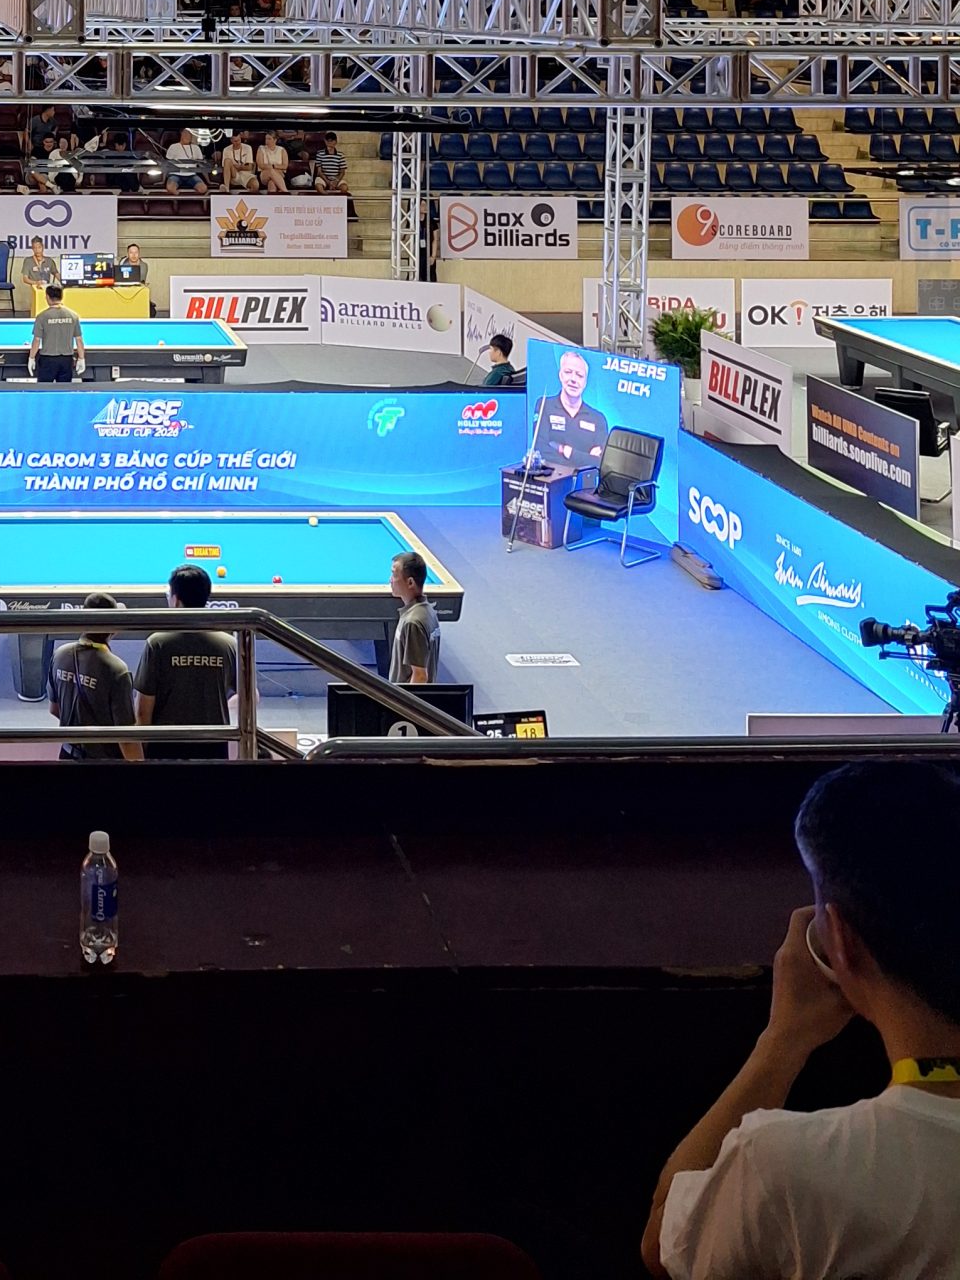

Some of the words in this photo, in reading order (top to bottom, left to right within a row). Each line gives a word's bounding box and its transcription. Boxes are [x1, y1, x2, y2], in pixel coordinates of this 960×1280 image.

[483, 208, 525, 227] box
[483, 228, 571, 247] billiards
[711, 224, 793, 237] SCOREBOARD
[7, 235, 92, 249] BILINITY
[222, 237, 263, 246] BILLIARDS
[94, 262, 107, 271] 21
[186, 296, 308, 324] BILLPLEX
[338, 302, 422, 322] aramith
[339, 318, 386, 328] BILLIARD
[391, 321, 422, 330] BALLS
[602, 357, 667, 381] JASPERS
[617, 379, 651, 398] DICK
[708, 359, 782, 424] BILLPLEX
[116, 400, 182, 426] HBSF
[97, 427, 130, 437] WORLD
[133, 427, 152, 437] CUP
[26, 453, 95, 468] CAROM
[99, 453, 111, 468] 3
[115, 449, 168, 468] BĂNG
[173, 450, 212, 469] CÚP
[216, 448, 254, 468] THẾ
[257, 450, 297, 468] GIỚI
[811, 422, 912, 489] billiards.sooplive.com
[24, 472, 88, 490] THÀNH
[93, 471, 136, 490] PHỐ
[137, 472, 168, 490] HỒ
[171, 472, 207, 491] CHÍ
[208, 476, 259, 491] MINH
[688, 486, 743, 551] SOOP
[171, 655, 224, 667] REFEREE
[522, 727, 537, 738] 18
